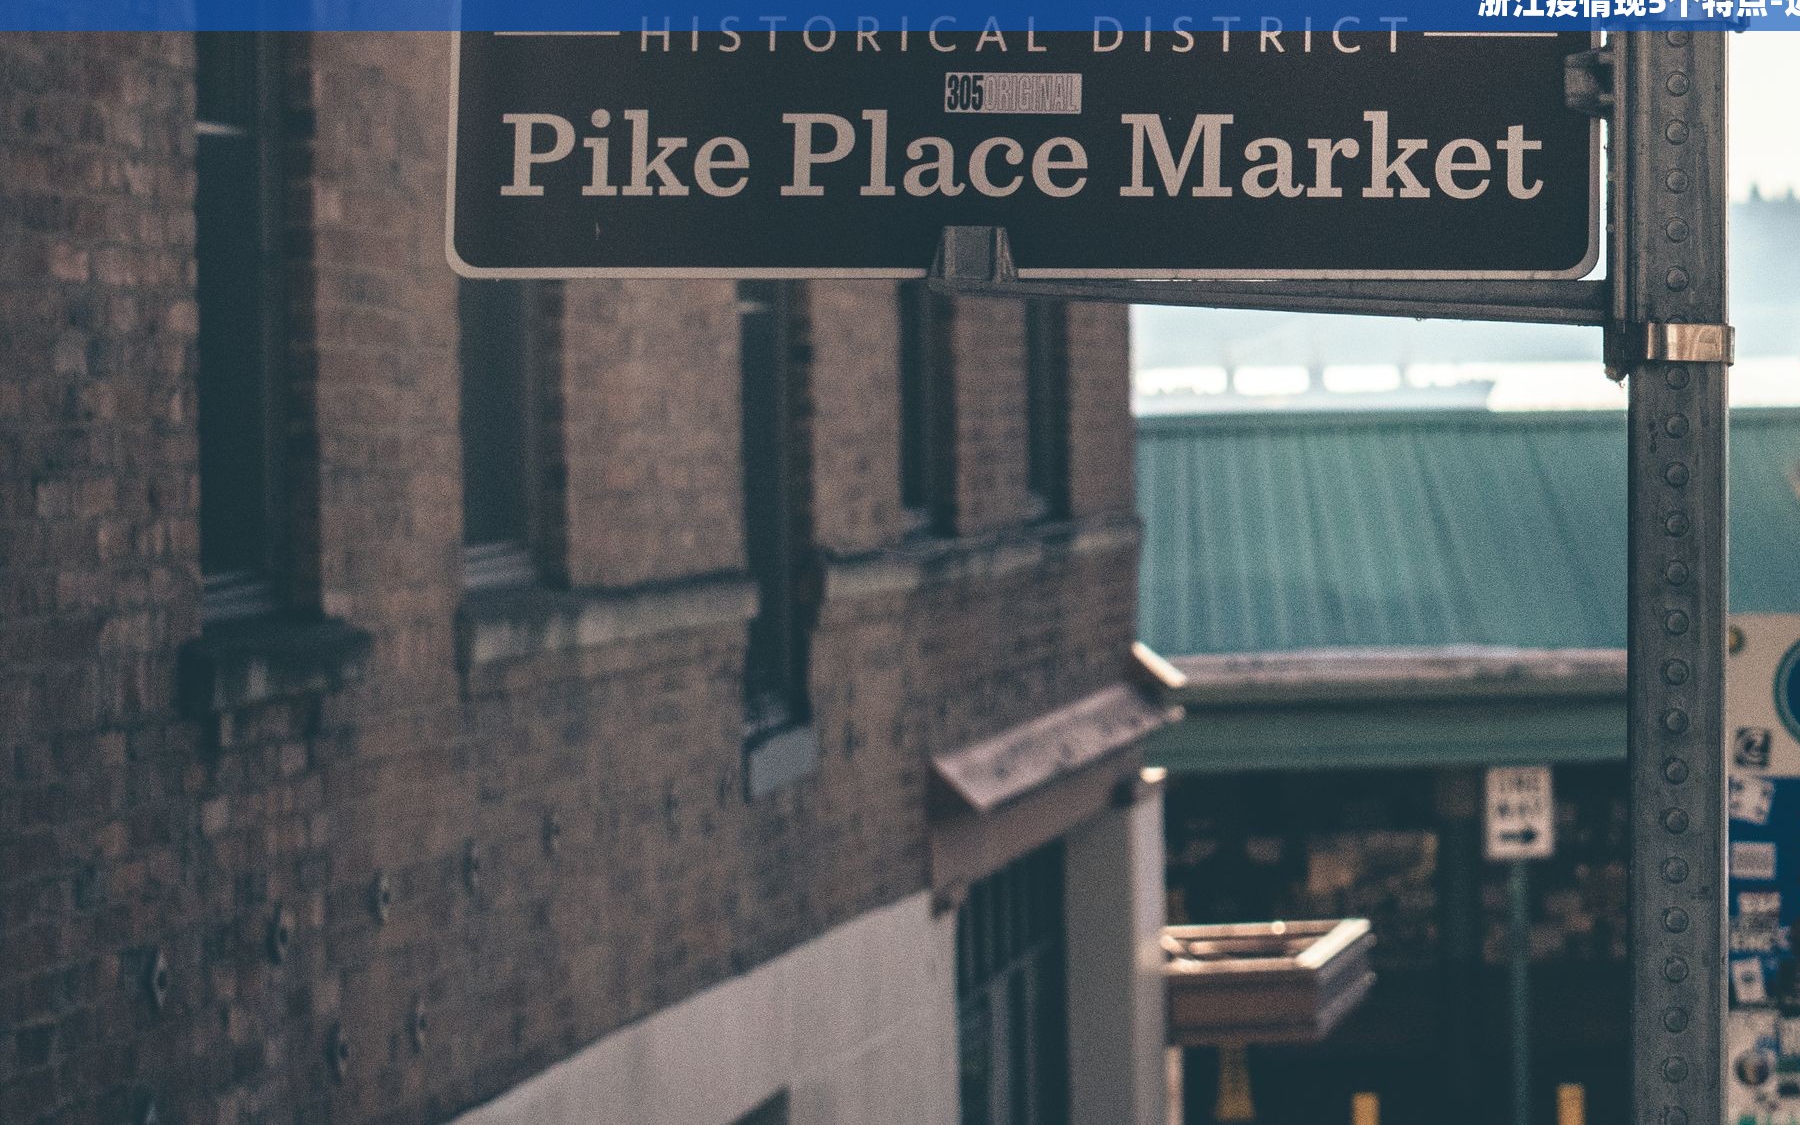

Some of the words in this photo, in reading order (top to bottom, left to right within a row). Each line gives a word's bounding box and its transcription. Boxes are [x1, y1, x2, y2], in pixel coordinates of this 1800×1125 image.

[641, 16, 1047, 52] HISTORICAL
[1093, 16, 1408, 52] DISTRICT
[500, 109, 750, 197] Pike
[781, 109, 1088, 198] Place
[1120, 110, 1543, 200] Market
